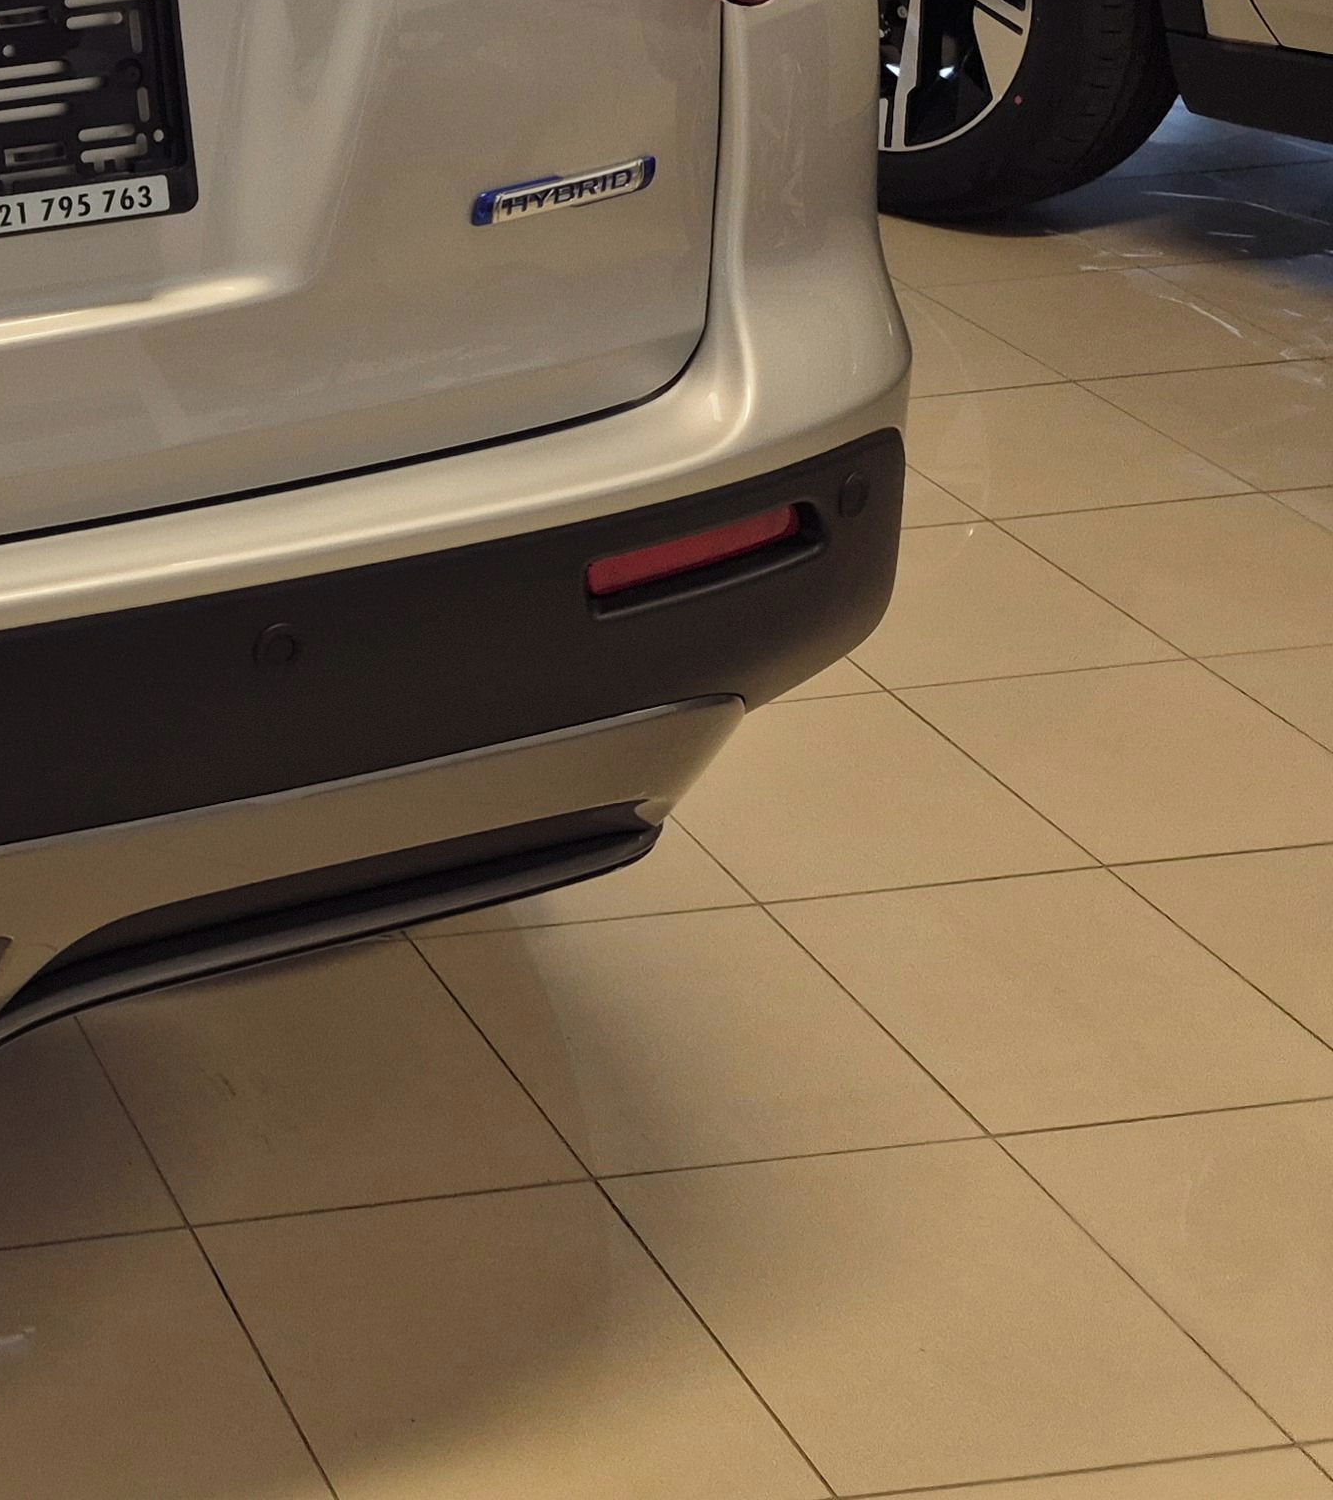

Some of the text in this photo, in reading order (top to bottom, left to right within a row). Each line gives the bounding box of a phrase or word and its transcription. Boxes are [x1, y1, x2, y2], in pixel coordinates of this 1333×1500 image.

[41, 192, 92, 221] 795
[102, 184, 154, 214] 763
[501, 168, 633, 215] HYBRID
